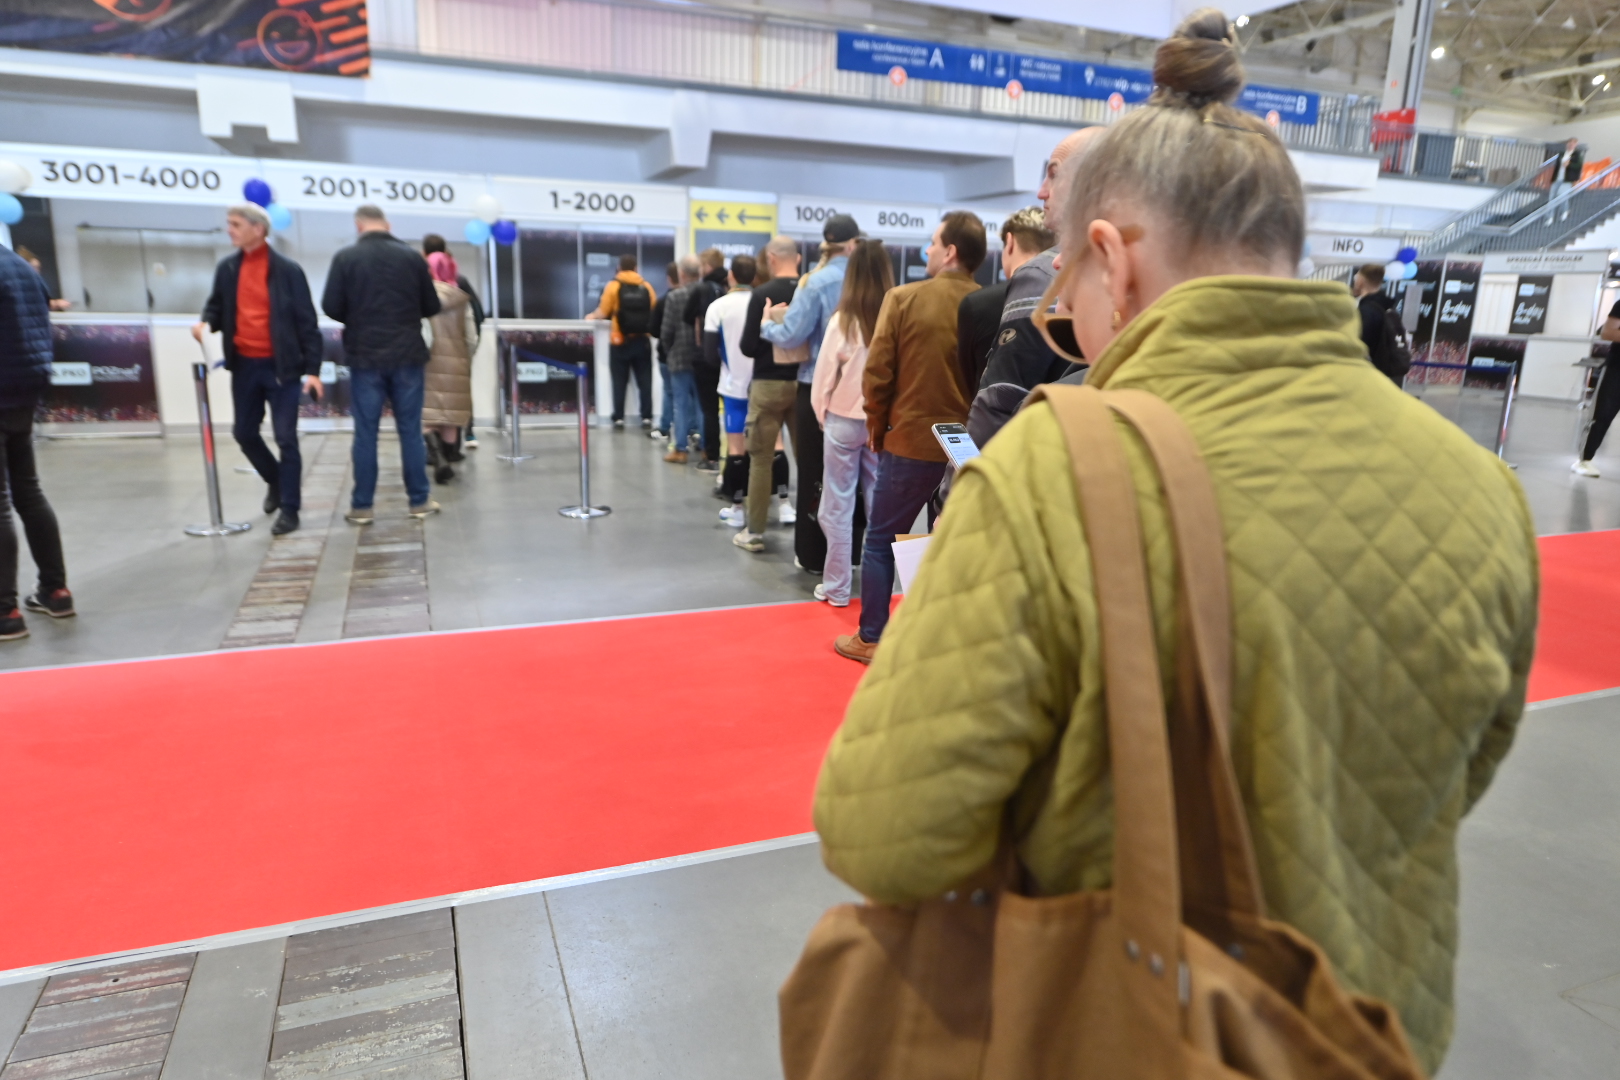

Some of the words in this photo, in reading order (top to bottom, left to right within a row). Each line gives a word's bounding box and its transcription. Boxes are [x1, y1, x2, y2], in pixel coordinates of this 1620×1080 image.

[929, 47, 945, 69] A
[1296, 95, 1307, 115] B
[41, 159, 221, 190] 3001-4000
[302, 176, 455, 202] 2001-3000
[550, 191, 635, 213] 1-2000
[878, 211, 925, 228] 800m
[1332, 238, 1364, 254] INFO
